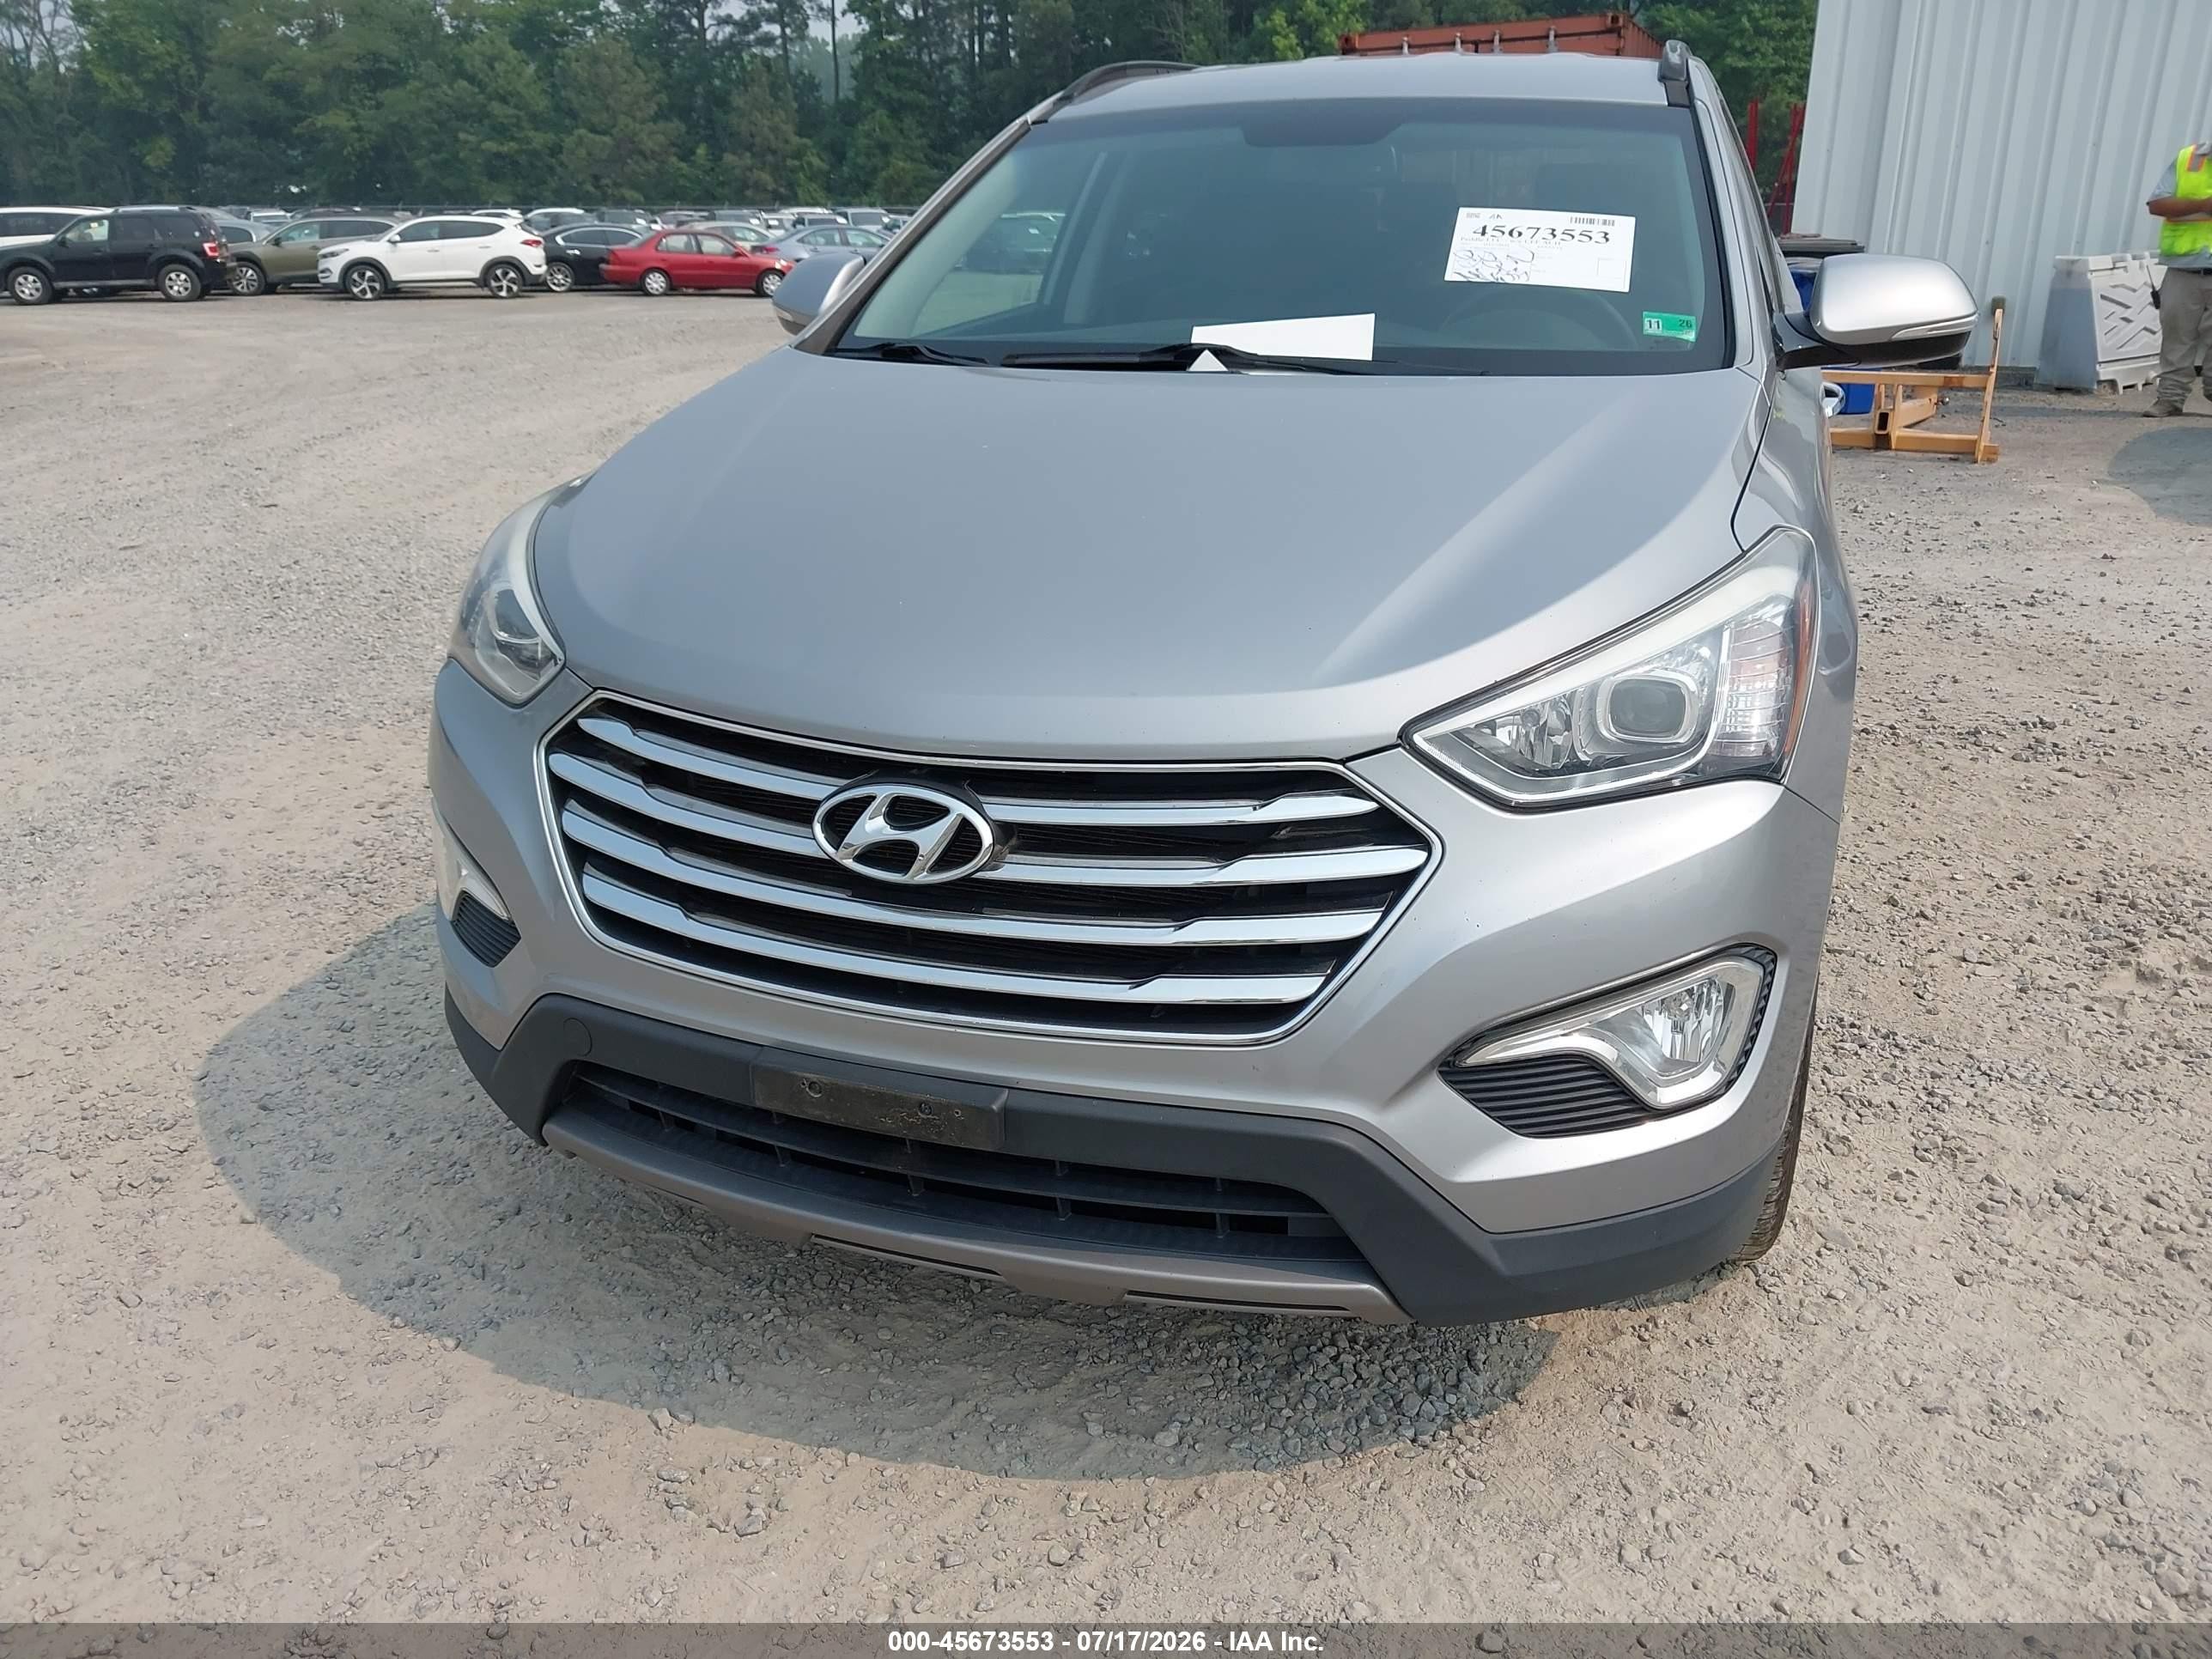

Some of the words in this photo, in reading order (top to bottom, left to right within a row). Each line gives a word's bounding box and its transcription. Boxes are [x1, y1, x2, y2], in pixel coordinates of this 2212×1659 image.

[1472, 224, 1612, 245] 45673553
[1646, 319, 1661, 330] 11
[1679, 319, 1692, 329] 26
